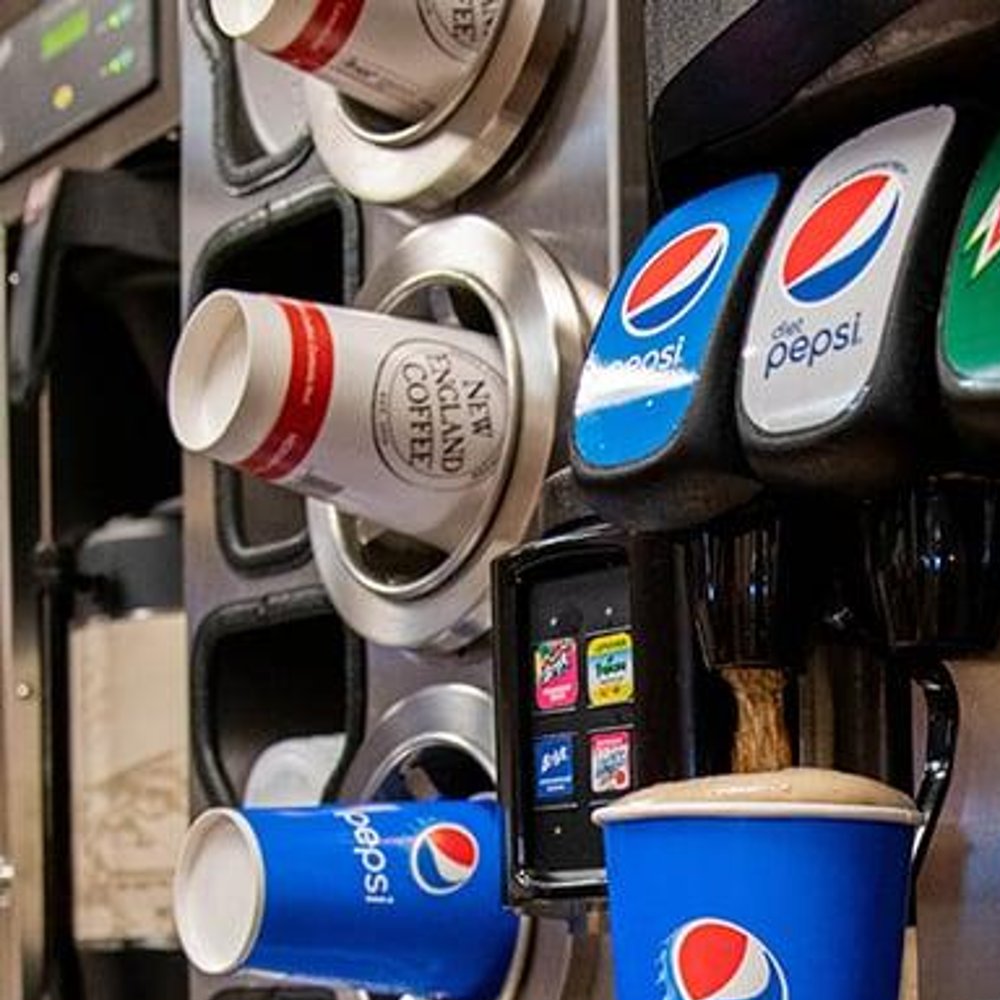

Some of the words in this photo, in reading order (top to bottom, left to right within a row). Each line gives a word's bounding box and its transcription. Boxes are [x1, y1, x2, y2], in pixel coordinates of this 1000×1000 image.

[764, 312, 862, 380] pepsi
[402, 361, 434, 470] COFFEE
[427, 353, 465, 473] ENGLAND
[463, 380, 494, 438] NEW
[333, 811, 395, 904] pepsi
